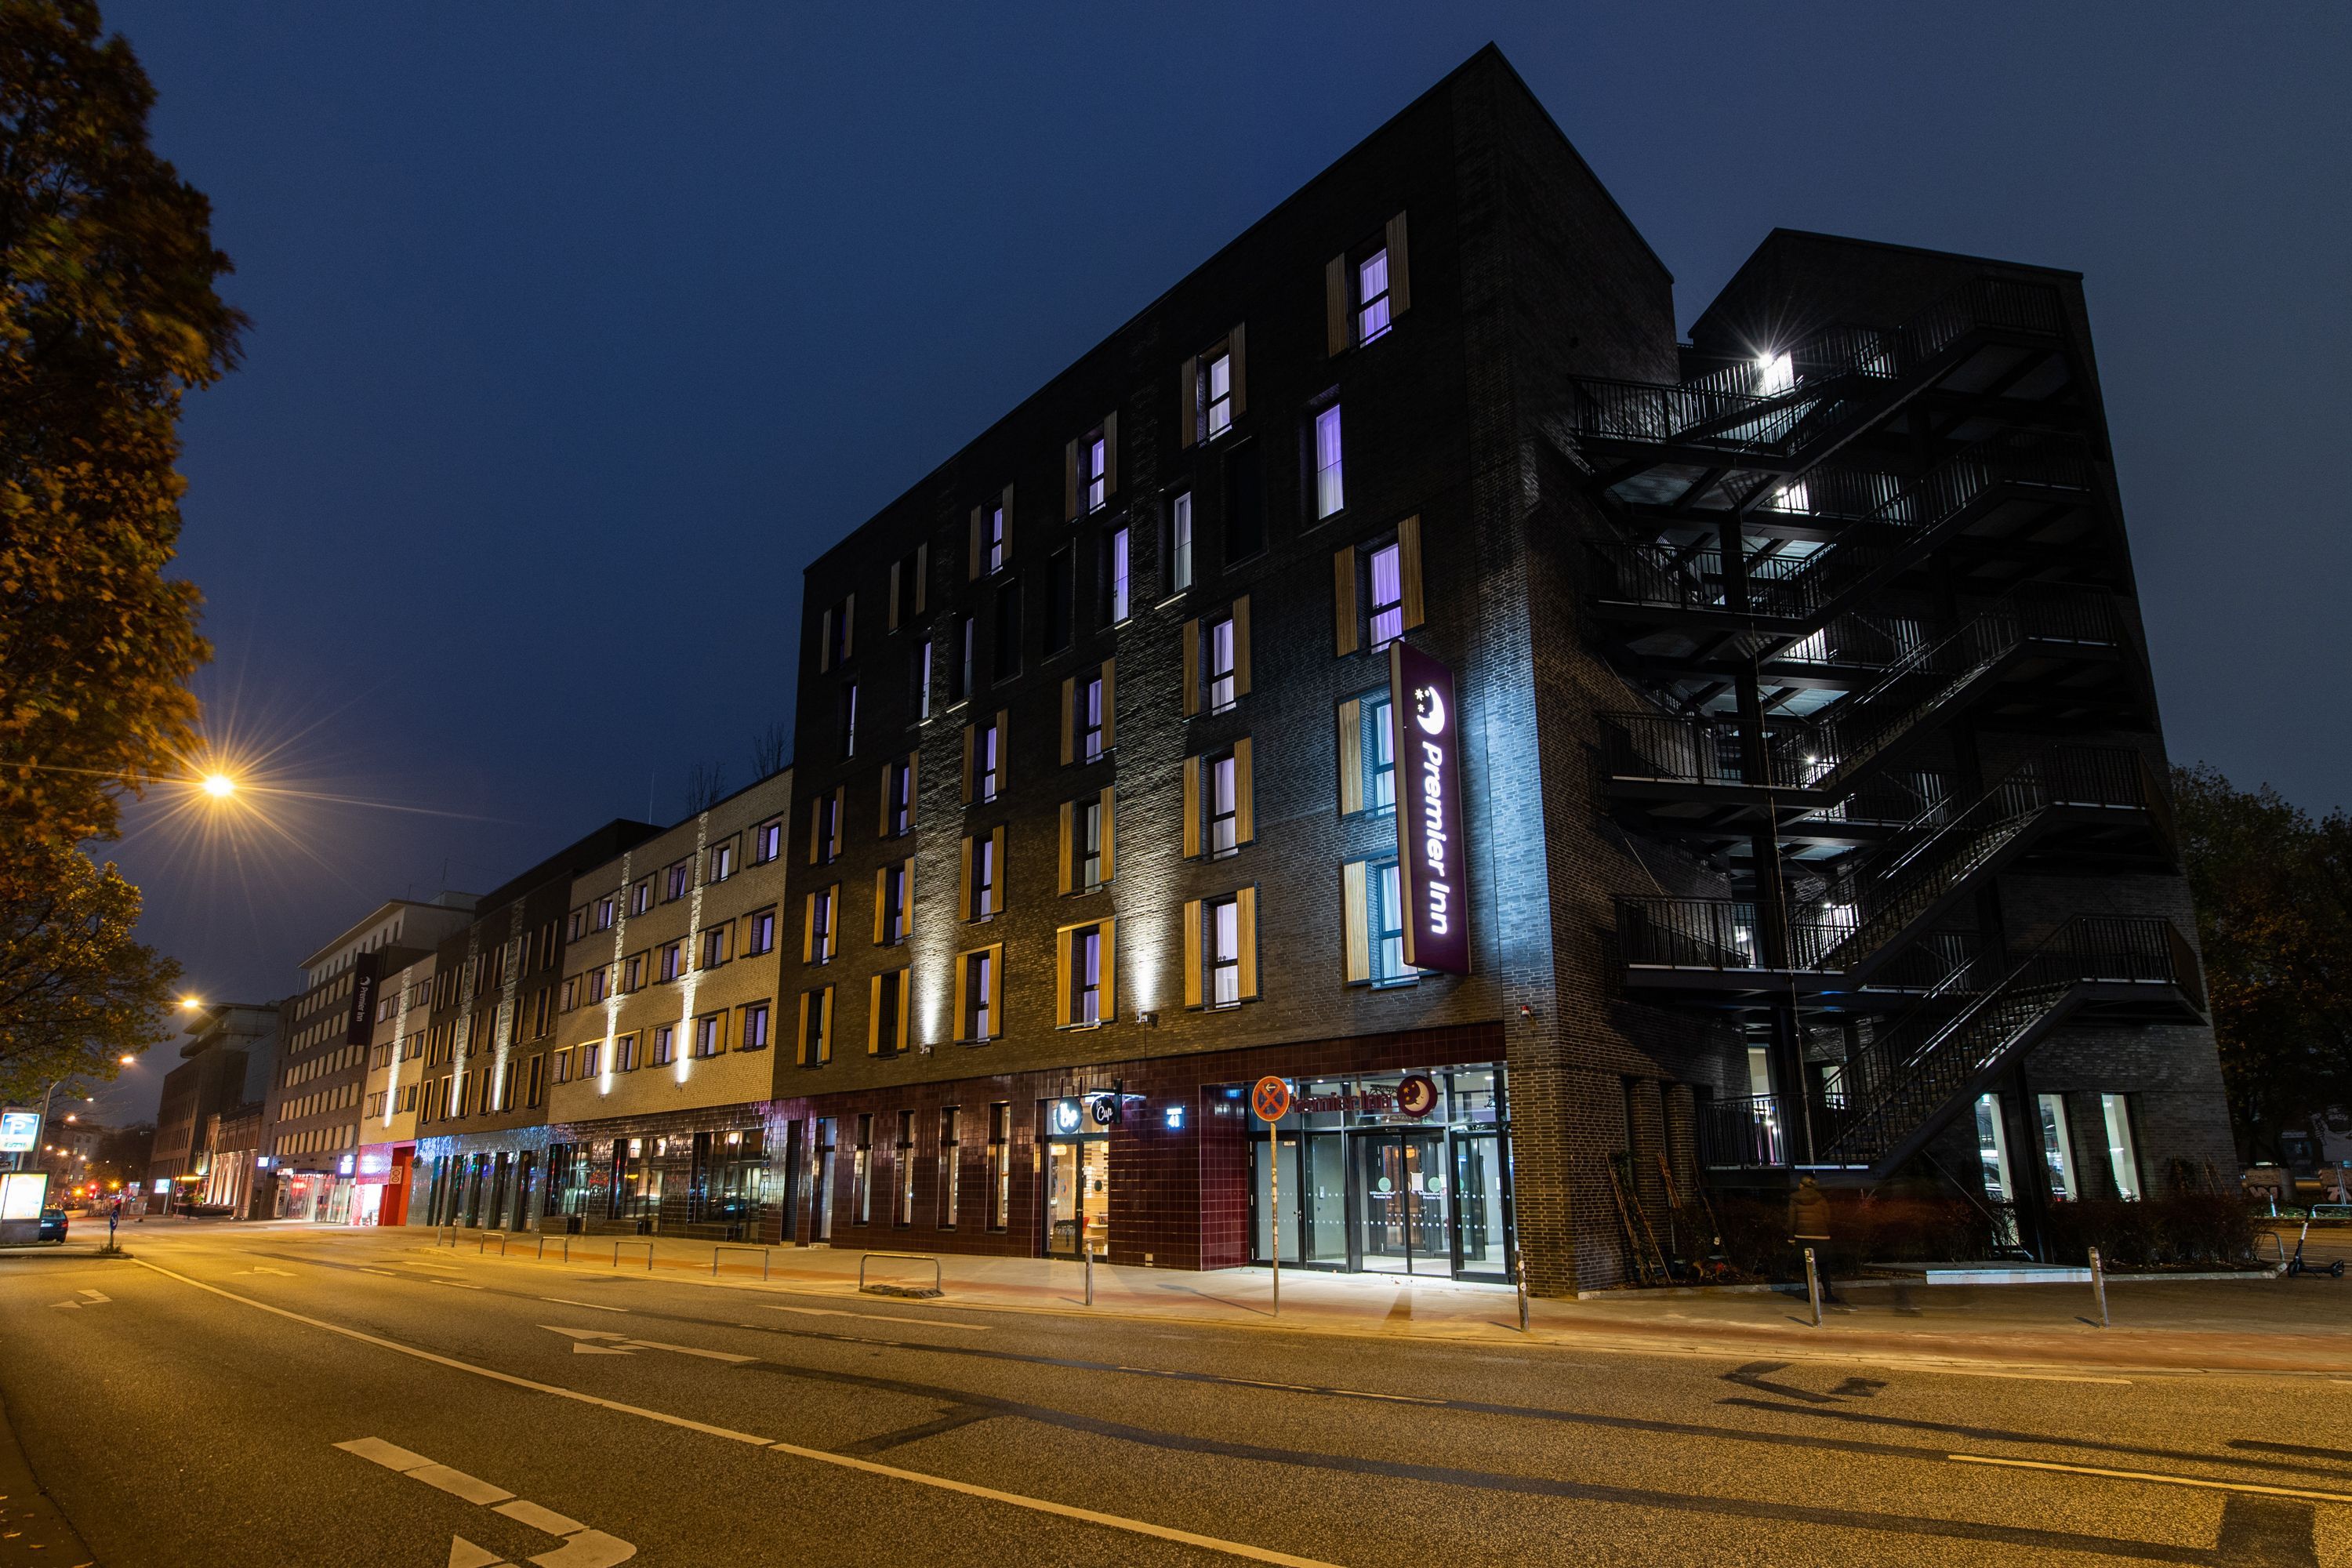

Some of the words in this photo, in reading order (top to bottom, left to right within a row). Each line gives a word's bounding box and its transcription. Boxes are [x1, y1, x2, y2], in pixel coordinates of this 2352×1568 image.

[1422, 740, 1447, 877] Premier
[1429, 880, 1450, 935] Inn
[358, 987, 368, 1011] Premier
[357, 1012, 365, 1022] Inn
[1360, 1090, 1393, 1110] Inn
[1097, 1105, 1113, 1121] Cup
[1167, 1114, 1180, 1127] 41
